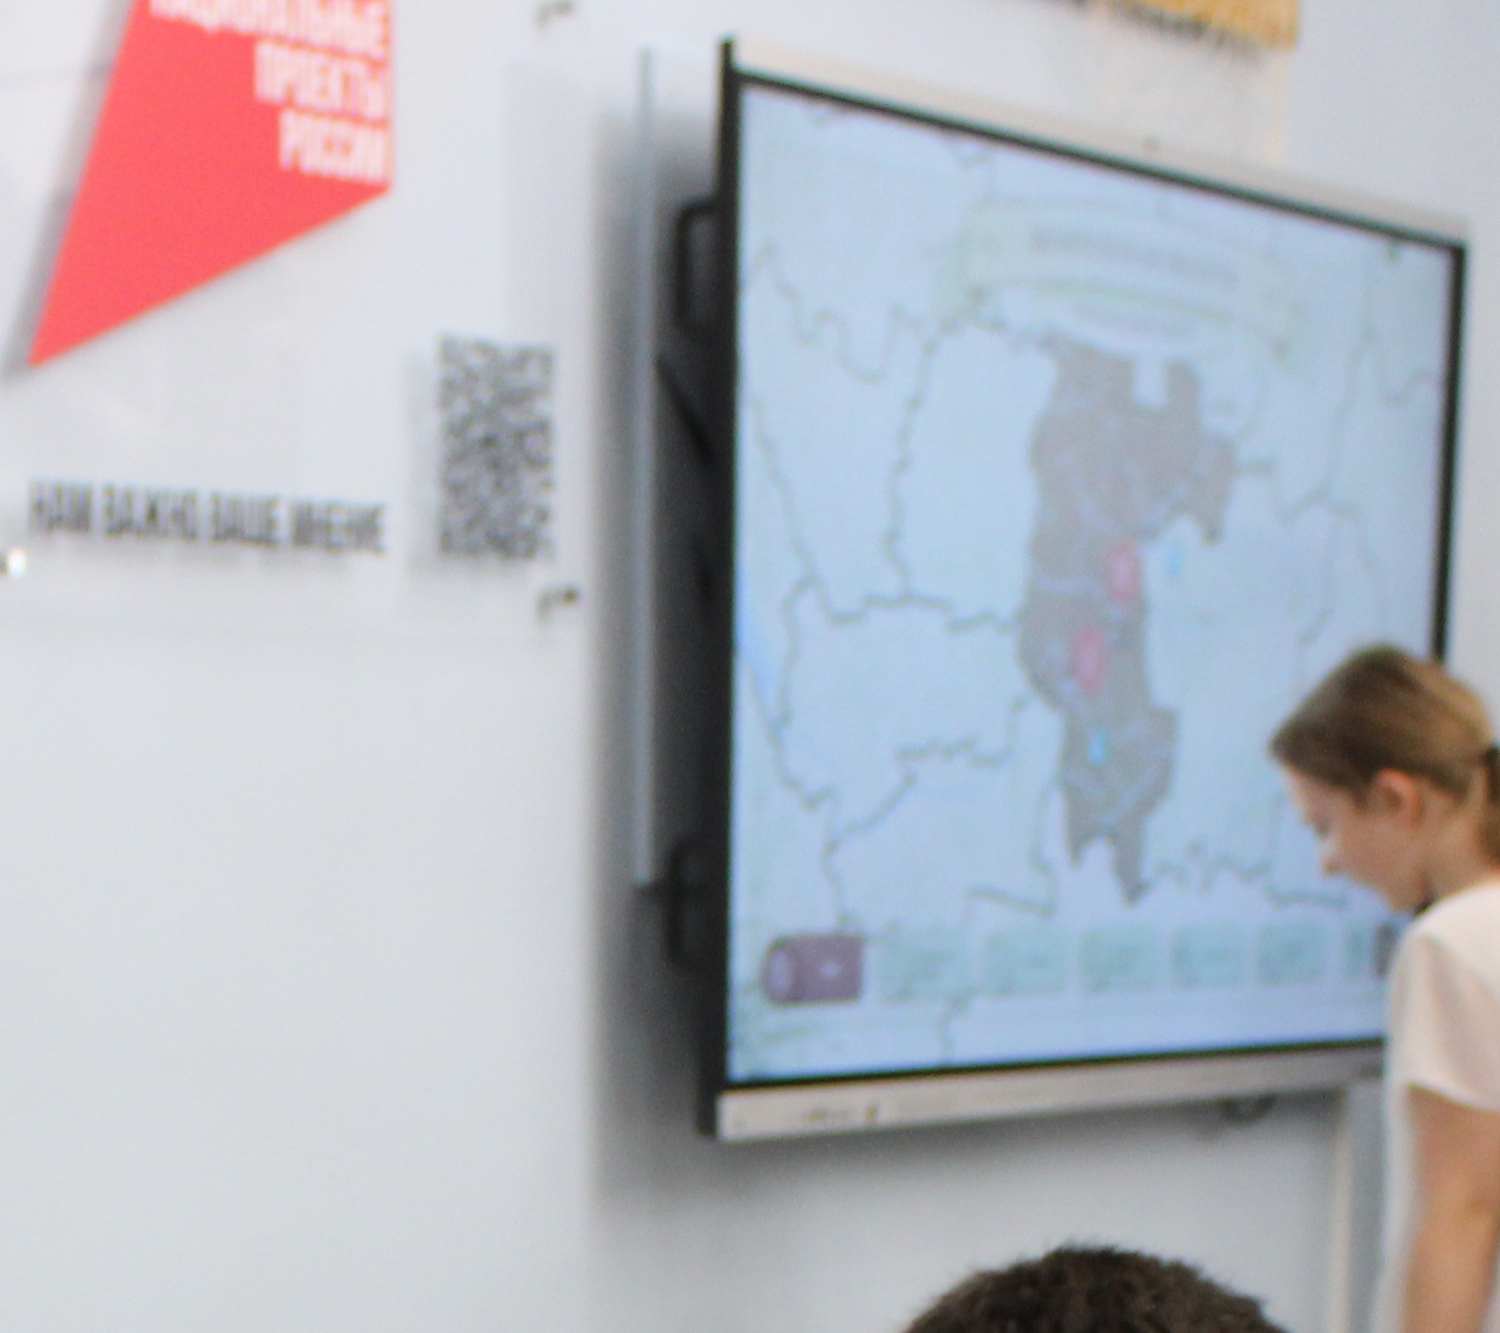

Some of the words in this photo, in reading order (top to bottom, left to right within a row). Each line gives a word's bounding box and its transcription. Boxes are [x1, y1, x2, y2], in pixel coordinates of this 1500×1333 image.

[150, 0, 387, 60] ИОНАЛЬНЫЕ
[255, 40, 387, 121] ПРОЕКТЫ
[278, 108, 387, 182] РОССИИ
[104, 484, 197, 542] ВАЖНО
